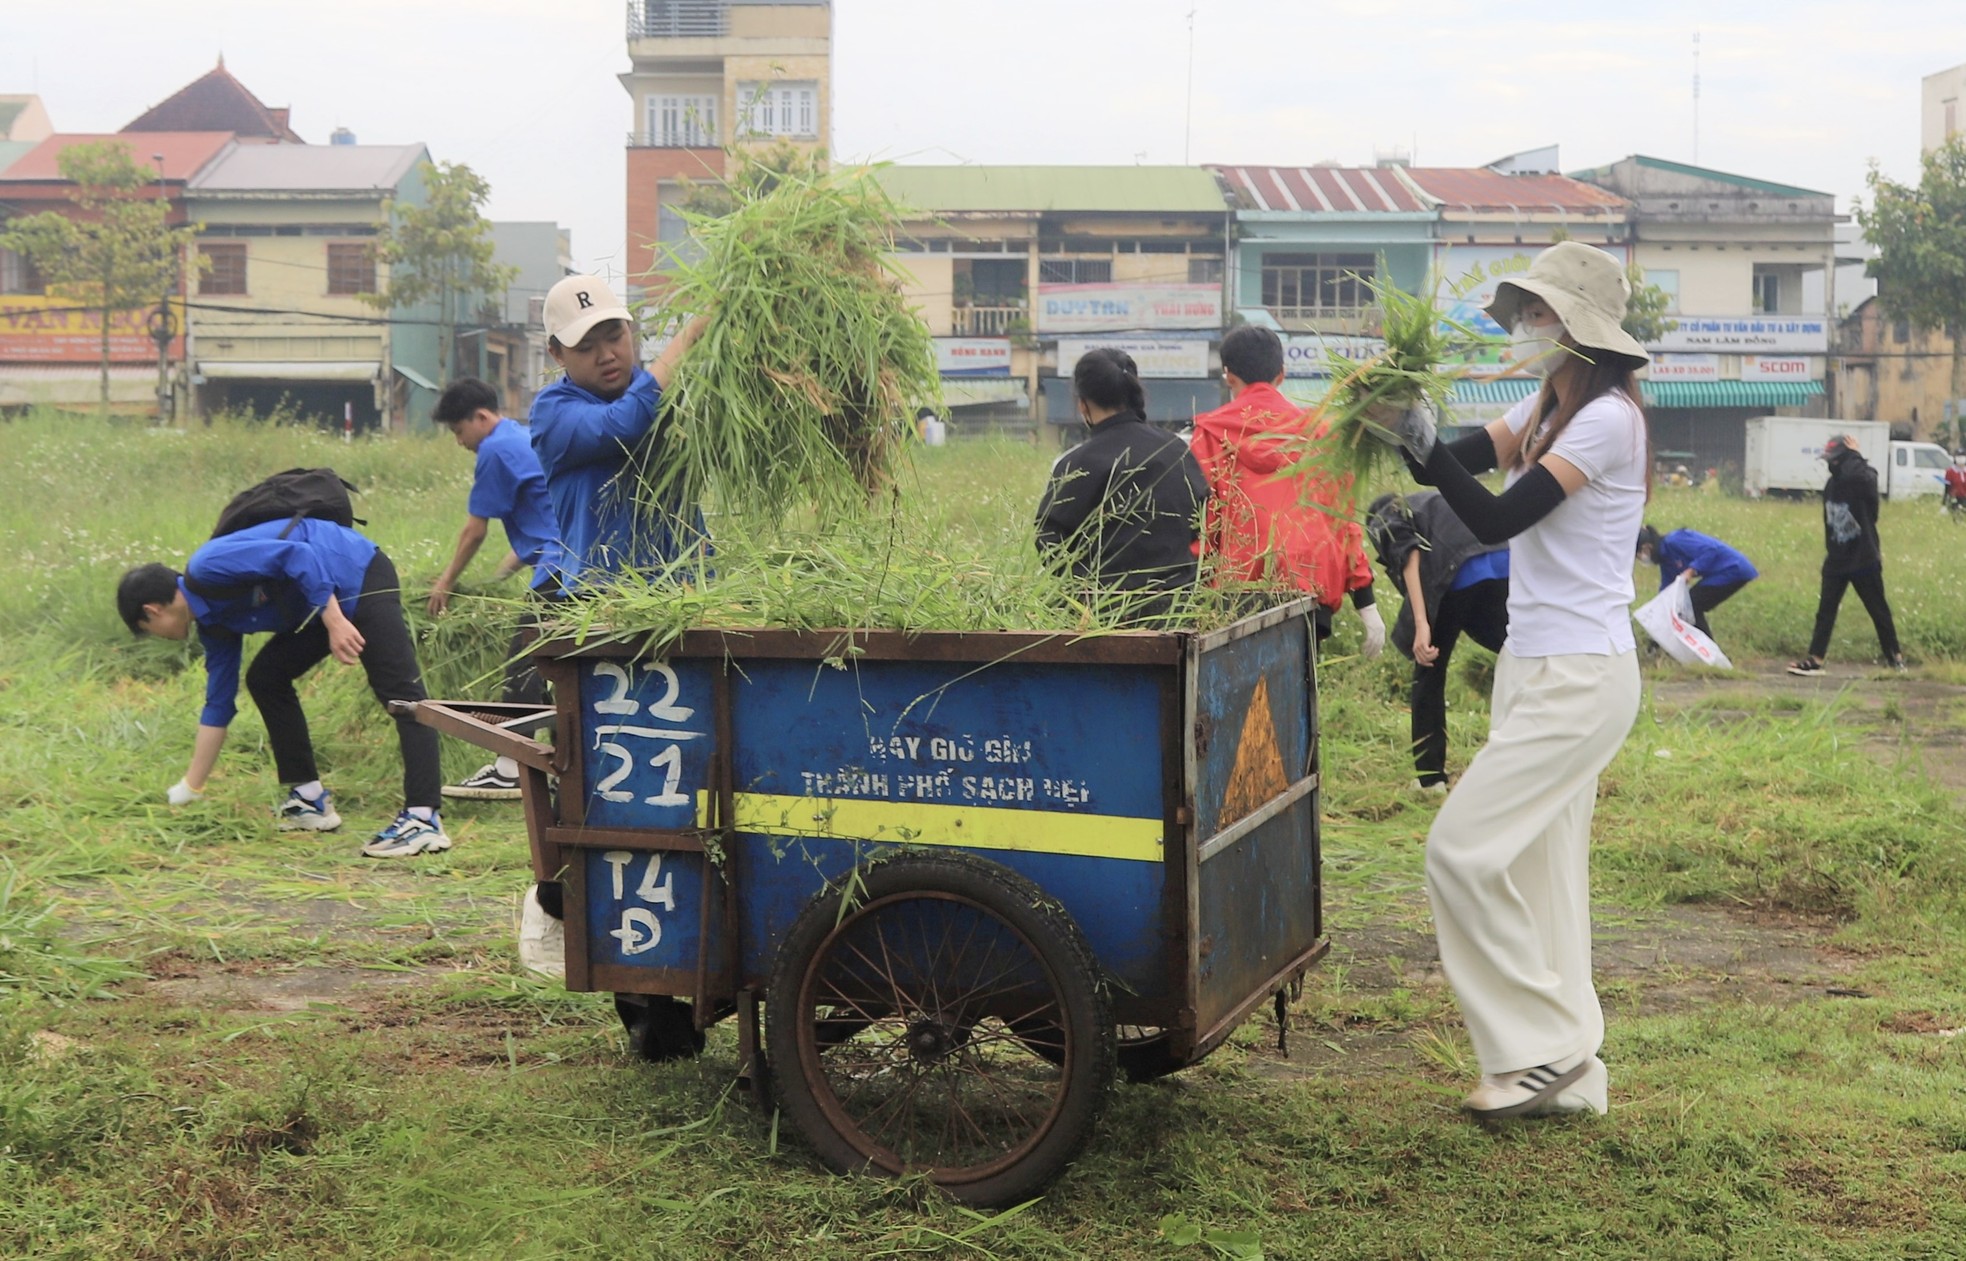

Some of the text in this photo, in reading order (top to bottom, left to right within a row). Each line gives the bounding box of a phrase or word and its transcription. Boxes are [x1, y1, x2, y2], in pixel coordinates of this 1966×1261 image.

[575, 291, 594, 309] R
[593, 661, 695, 722] 22
[597, 742, 690, 806] 21
